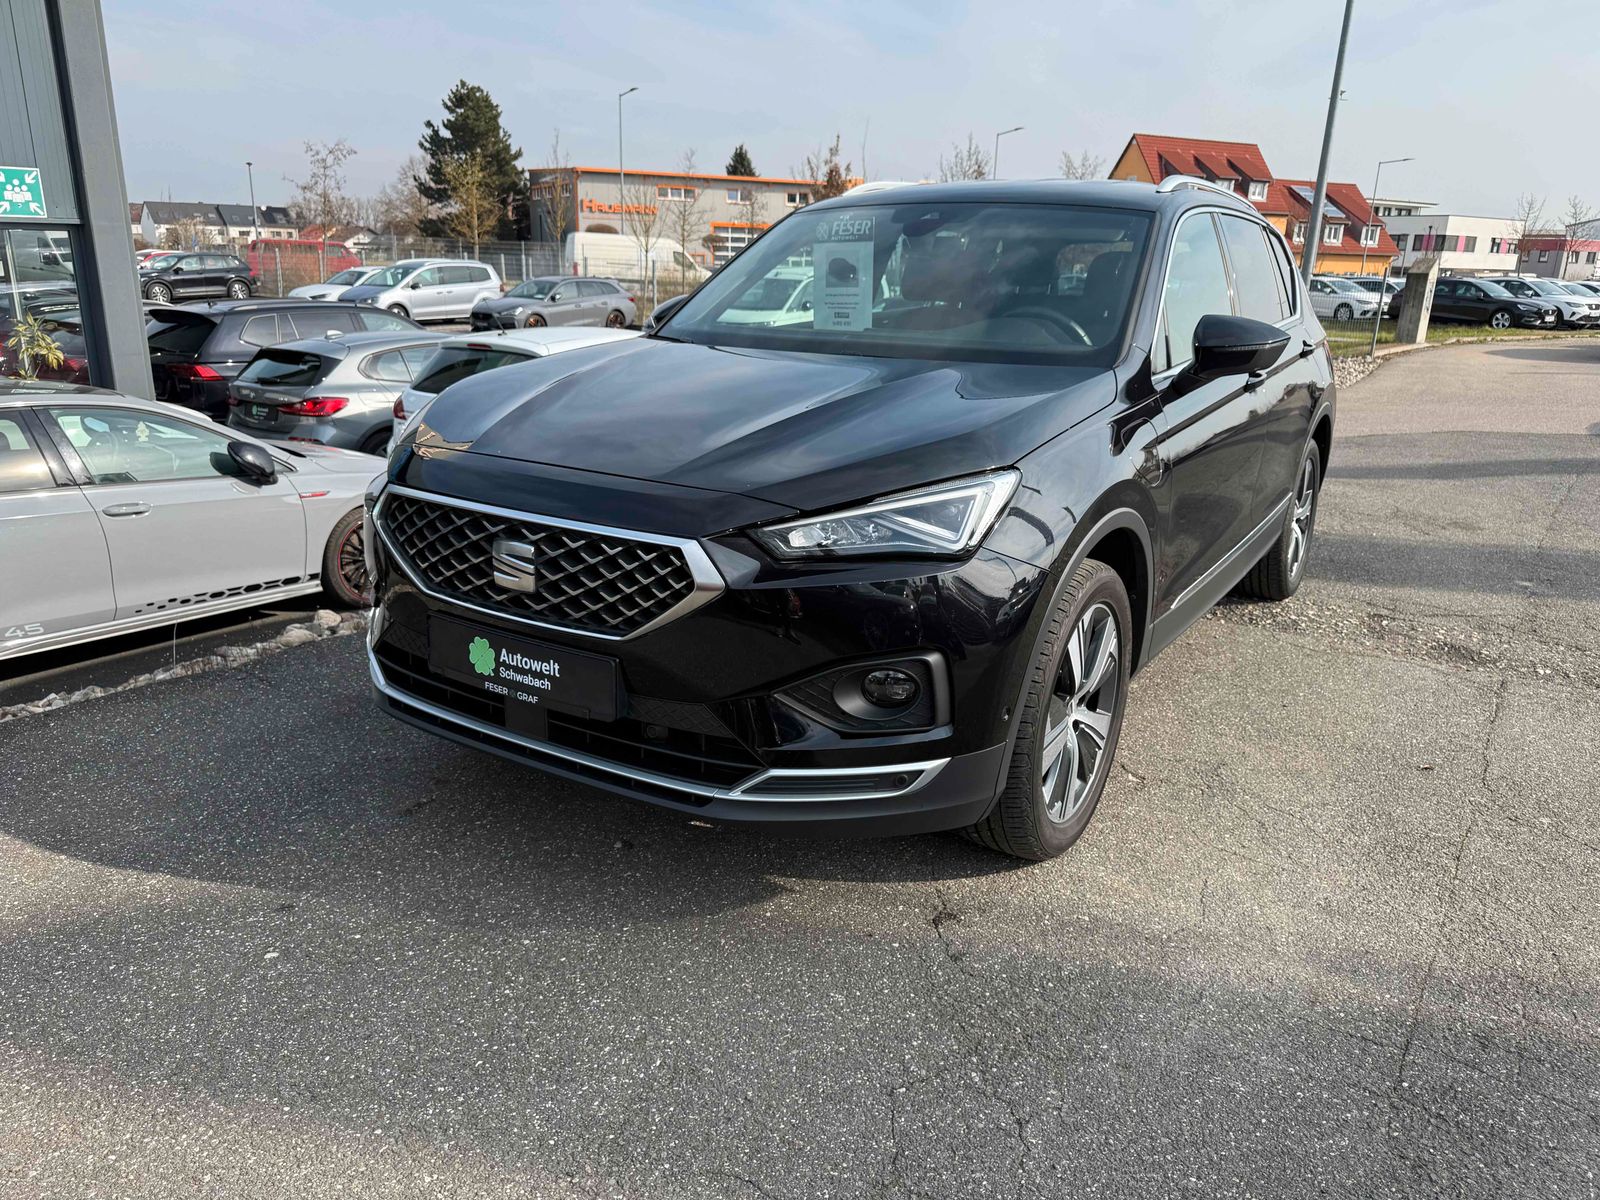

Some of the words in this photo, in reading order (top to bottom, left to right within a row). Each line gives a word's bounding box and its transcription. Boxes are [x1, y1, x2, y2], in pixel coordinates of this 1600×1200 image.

[832, 220, 871, 235] FESER
[5, 623, 44, 637] 45
[500, 648, 560, 677] Autowelt
[499, 667, 551, 691] Schwabach
[484, 681, 508, 696] FESER
[517, 691, 539, 704] GRAF
